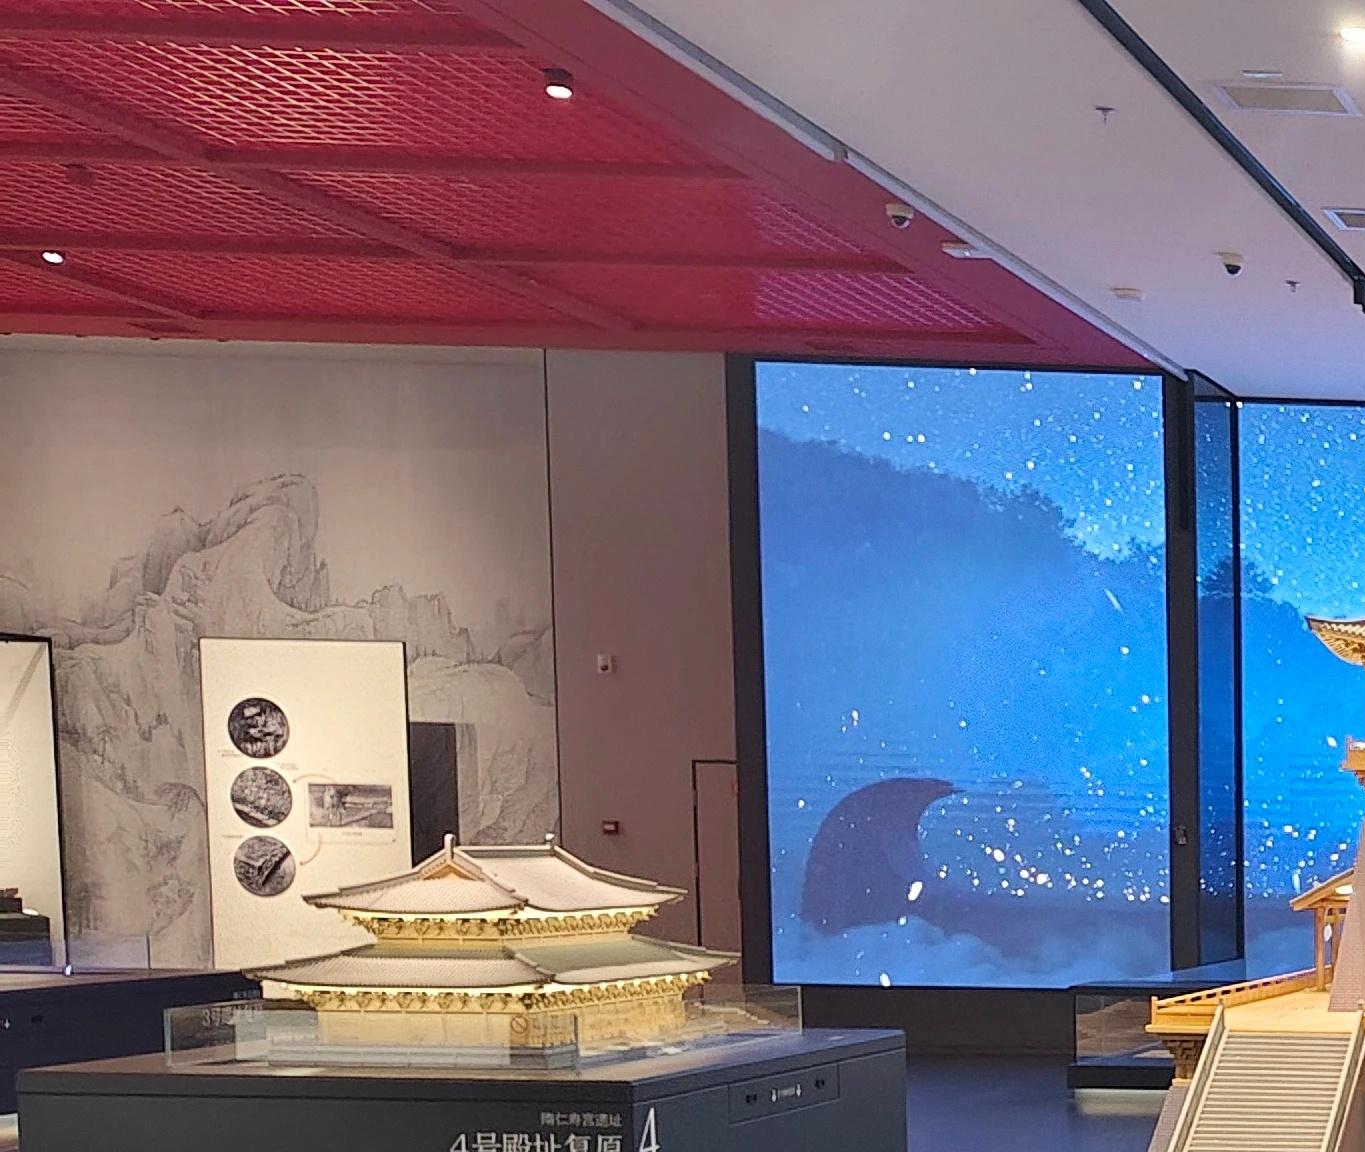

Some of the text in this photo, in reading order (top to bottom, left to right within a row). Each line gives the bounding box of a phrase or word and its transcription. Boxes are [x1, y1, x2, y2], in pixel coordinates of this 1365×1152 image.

[541, 1112, 623, 1128] 隋仁寿宫遗址
